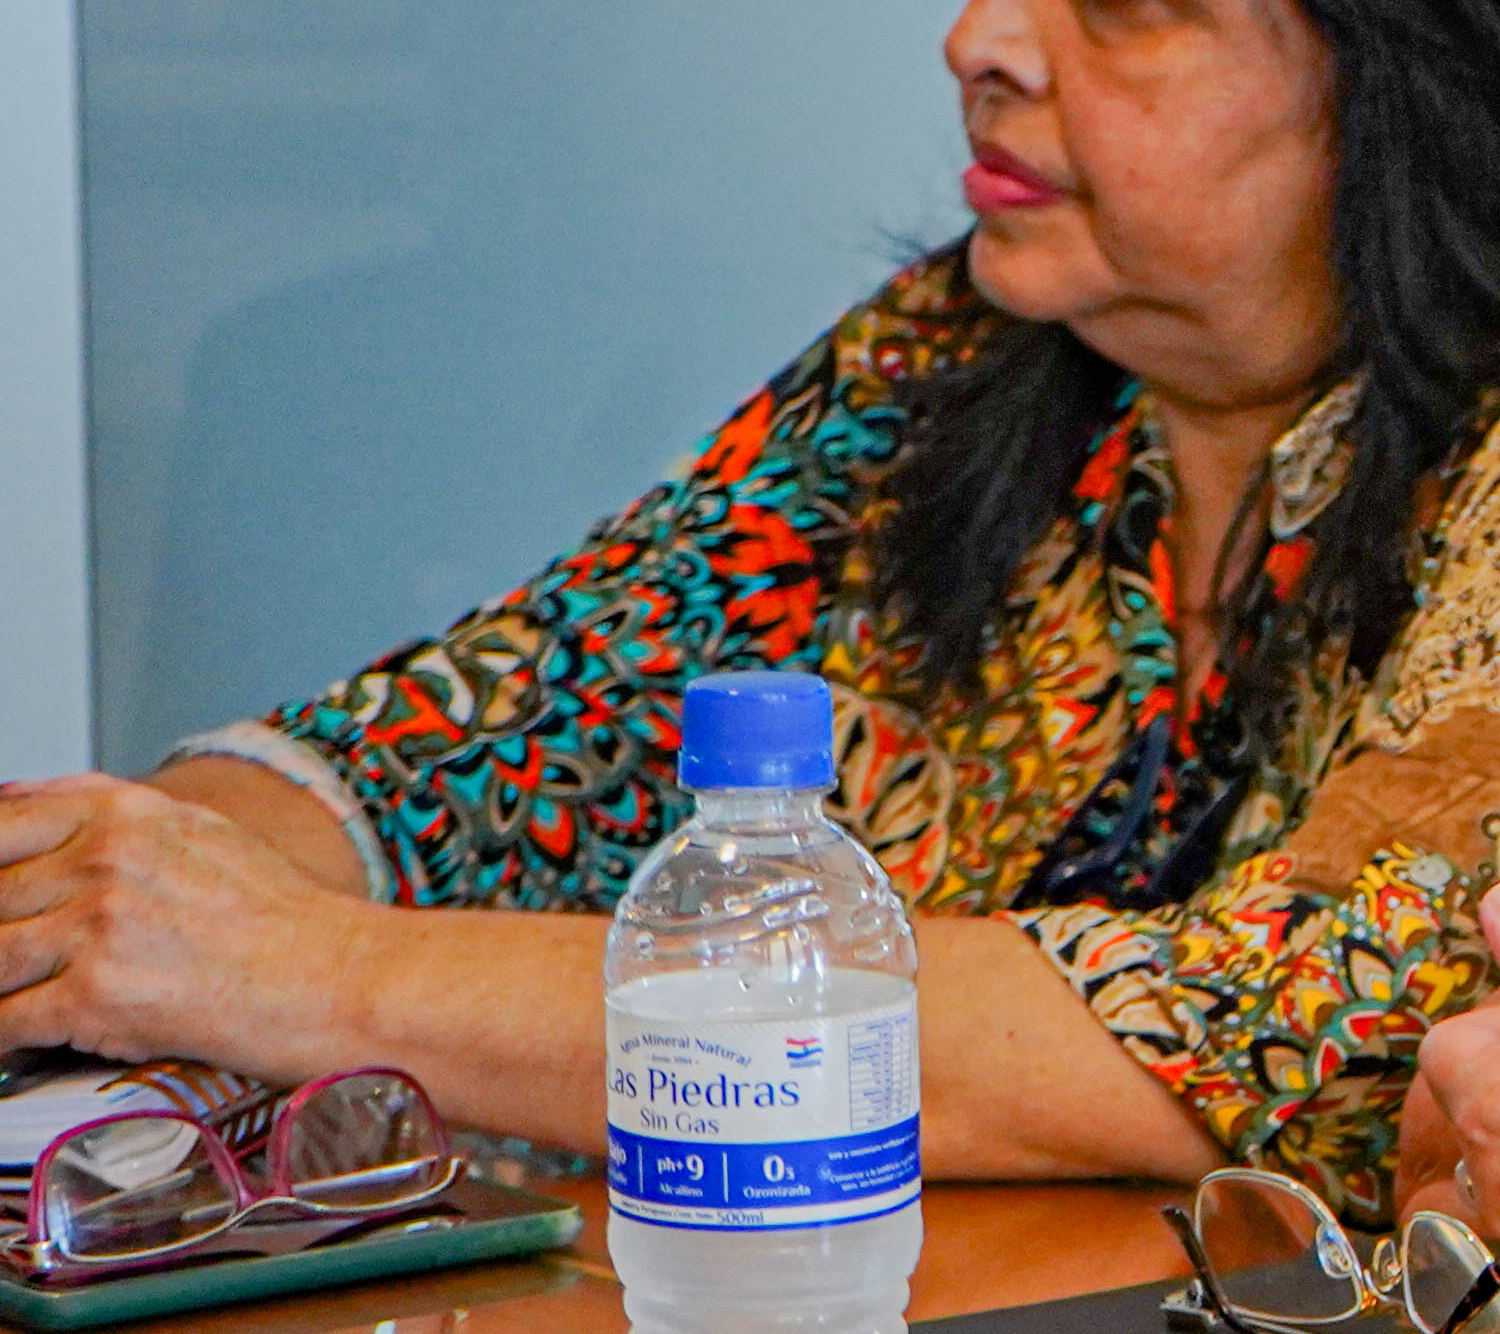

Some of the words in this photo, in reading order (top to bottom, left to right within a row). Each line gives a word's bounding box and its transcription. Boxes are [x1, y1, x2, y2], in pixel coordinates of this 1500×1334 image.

[642, 1033, 690, 1049] Mineral
[695, 1038, 752, 1068] Natural
[648, 1066, 800, 1109] Piedras
[640, 1106, 668, 1131] Sin
[675, 1111, 720, 1135] Gas
[742, 1184, 812, 1199] Ozonizada
